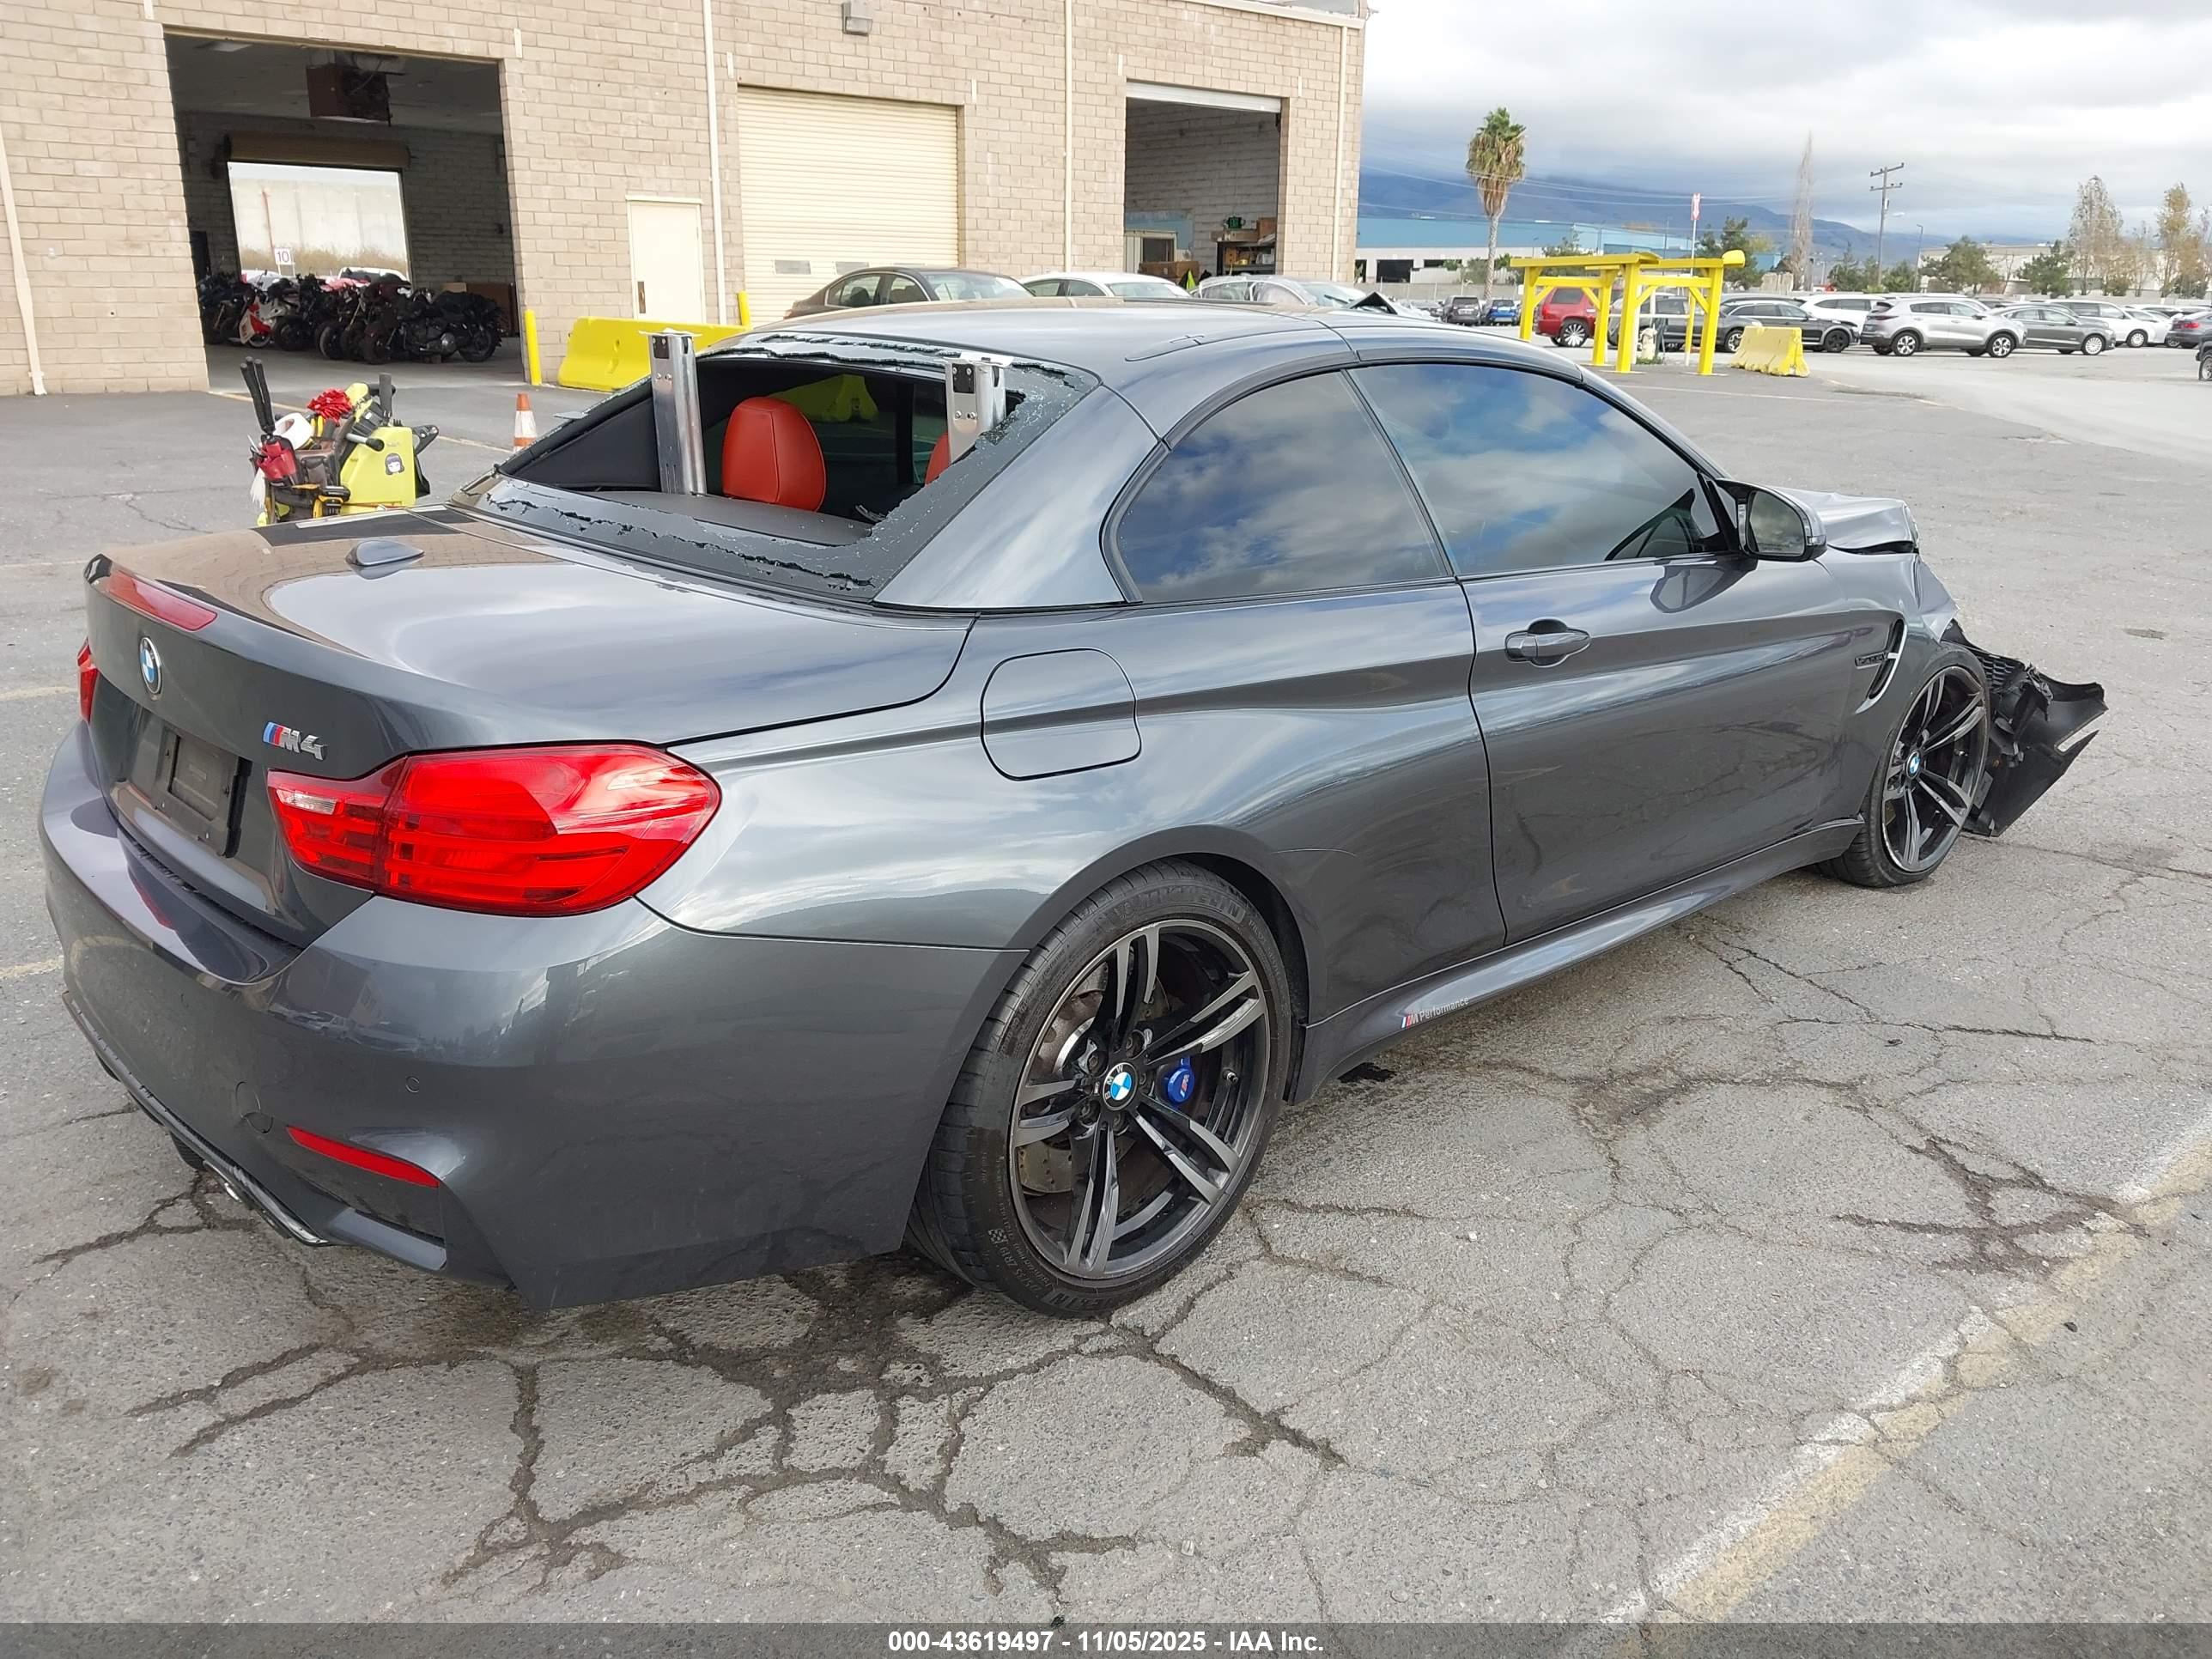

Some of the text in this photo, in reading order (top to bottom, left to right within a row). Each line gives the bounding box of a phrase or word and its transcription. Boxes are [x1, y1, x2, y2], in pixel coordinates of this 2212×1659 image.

[276, 251, 289, 262] 10
[276, 725, 324, 760] M4
[1419, 997, 1469, 1021] Performance
